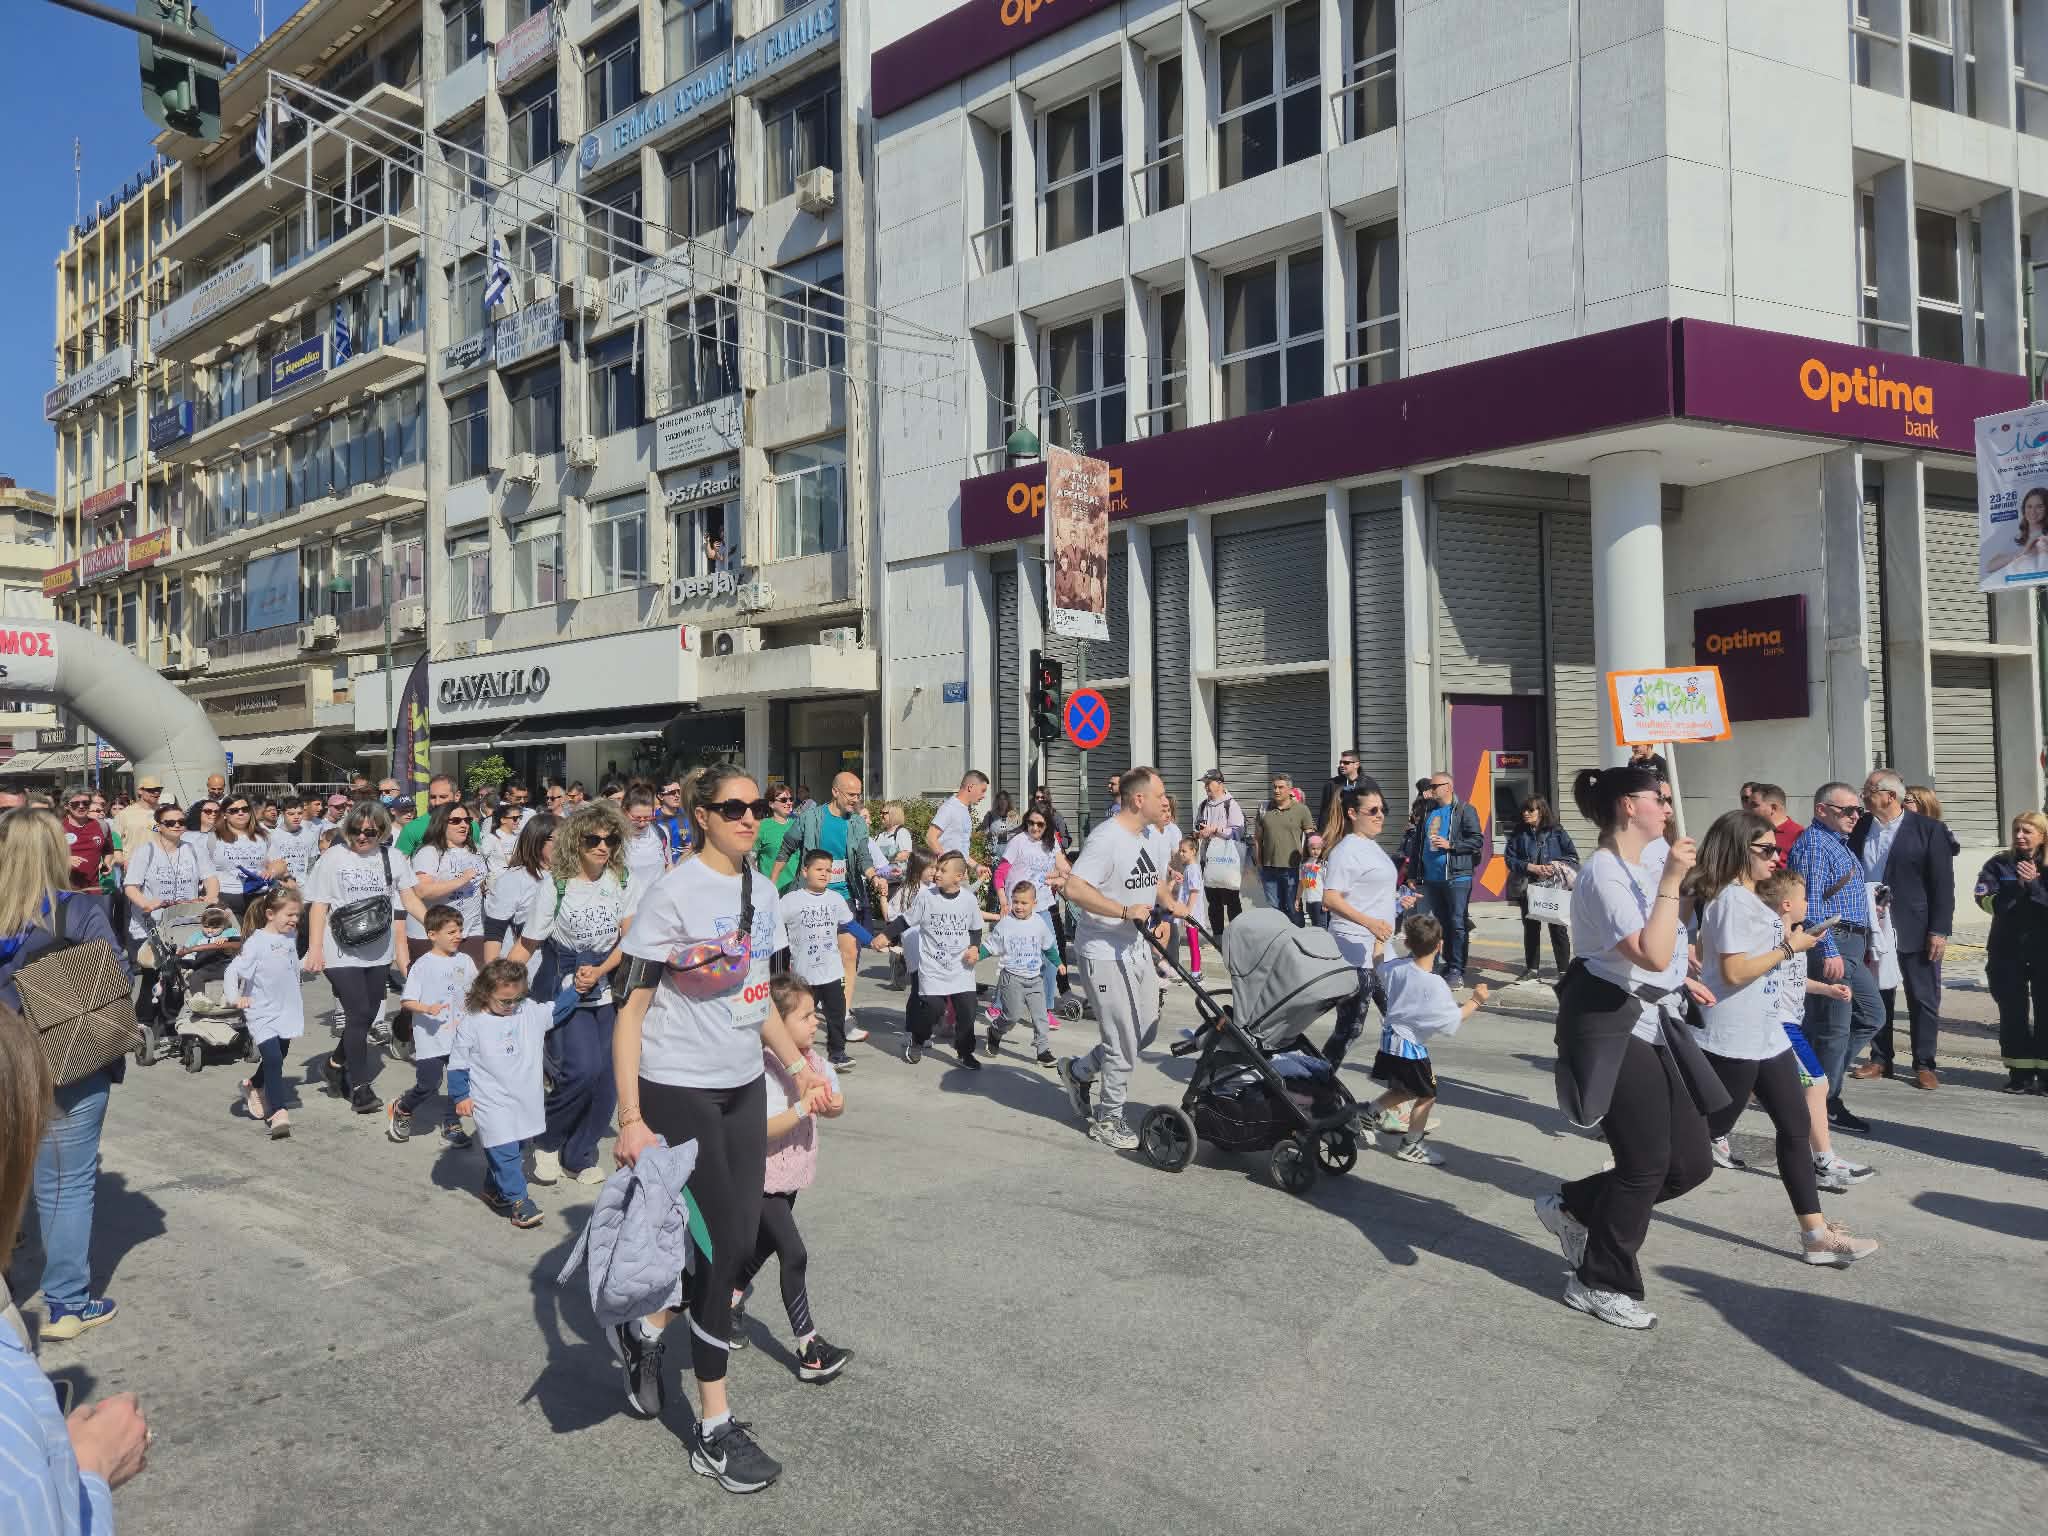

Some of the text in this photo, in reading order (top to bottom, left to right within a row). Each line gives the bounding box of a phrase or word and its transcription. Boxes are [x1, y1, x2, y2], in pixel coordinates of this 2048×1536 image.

[1799, 358, 1934, 415] Optima
[1904, 415, 1940, 440] bank
[1706, 627, 1782, 656] Optima
[439, 665, 550, 705] CAVALLO
[1124, 873, 1159, 890] adidas
